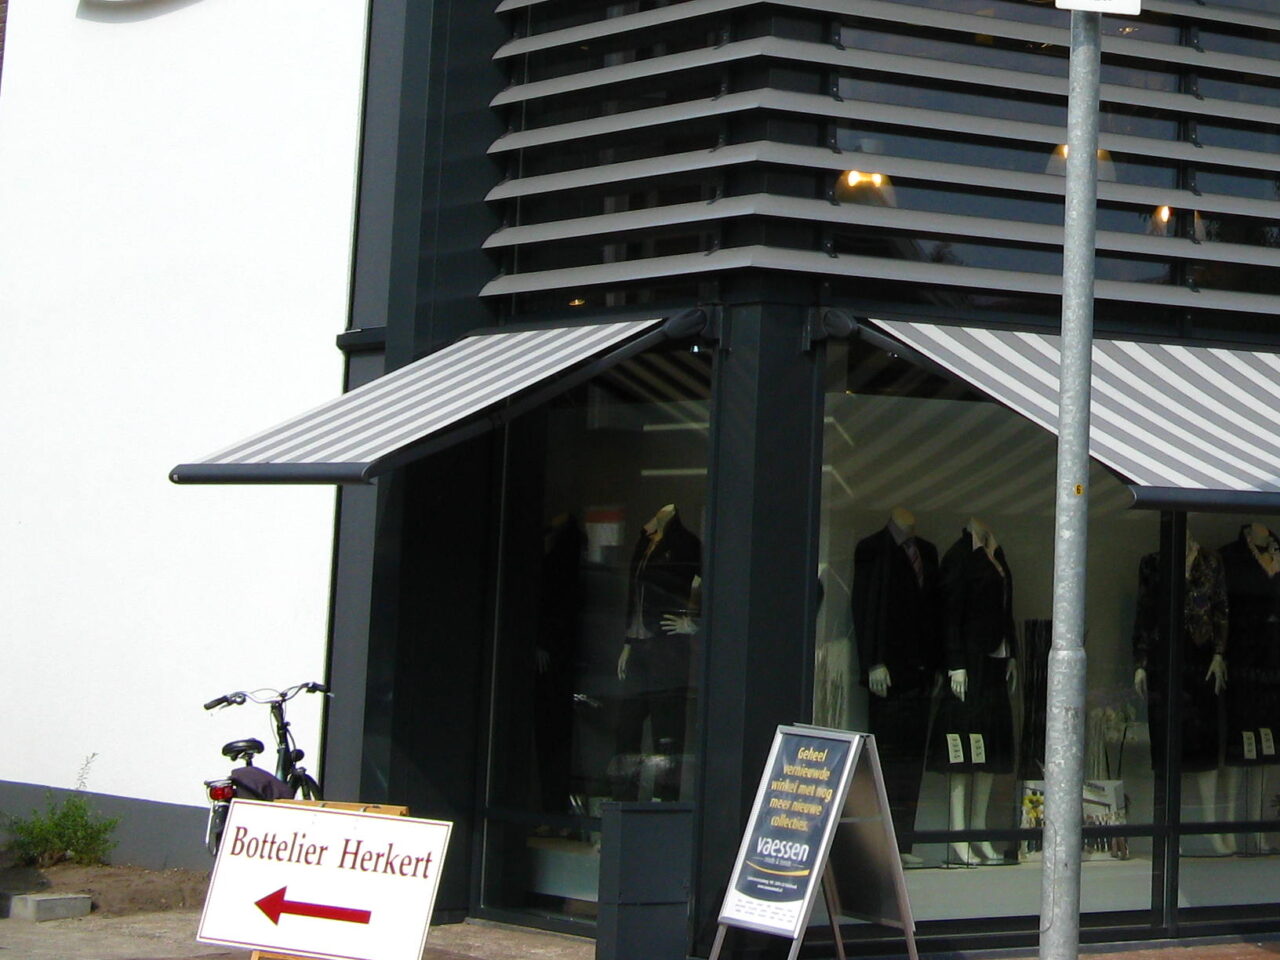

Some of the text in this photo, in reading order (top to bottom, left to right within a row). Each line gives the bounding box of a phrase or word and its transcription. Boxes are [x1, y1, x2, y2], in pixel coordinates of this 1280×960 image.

[797, 747, 828, 762] Geheel
[783, 764, 831, 781] vernieuwde
[797, 784, 815, 796] met
[815, 787, 834, 803] nog
[791, 799, 823, 816] nieuwe
[230, 826, 433, 880] Bottelier Herkert
[756, 836, 810, 862] vaessen
